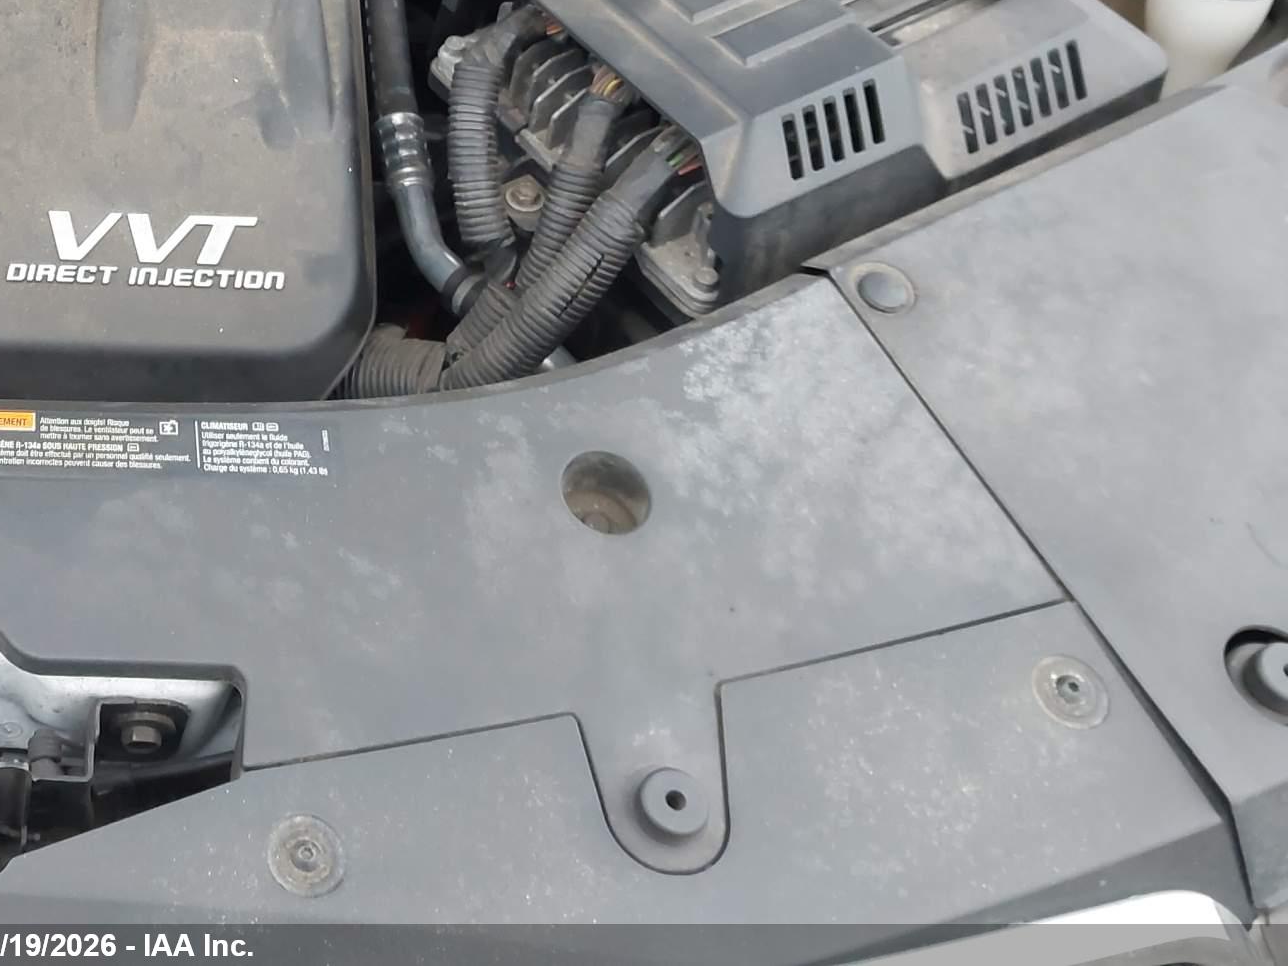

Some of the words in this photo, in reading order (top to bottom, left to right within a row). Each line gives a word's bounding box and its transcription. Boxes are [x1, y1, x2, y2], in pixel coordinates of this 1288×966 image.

[48, 210, 259, 265] VVT
[6, 263, 118, 285] DIRECT
[127, 266, 285, 290] INJECTION
[15, 441, 42, 449] R-134a
[42, 442, 62, 450] SOUS
[62, 442, 87, 451] HAUTE
[87, 443, 124, 452] PRESSION
